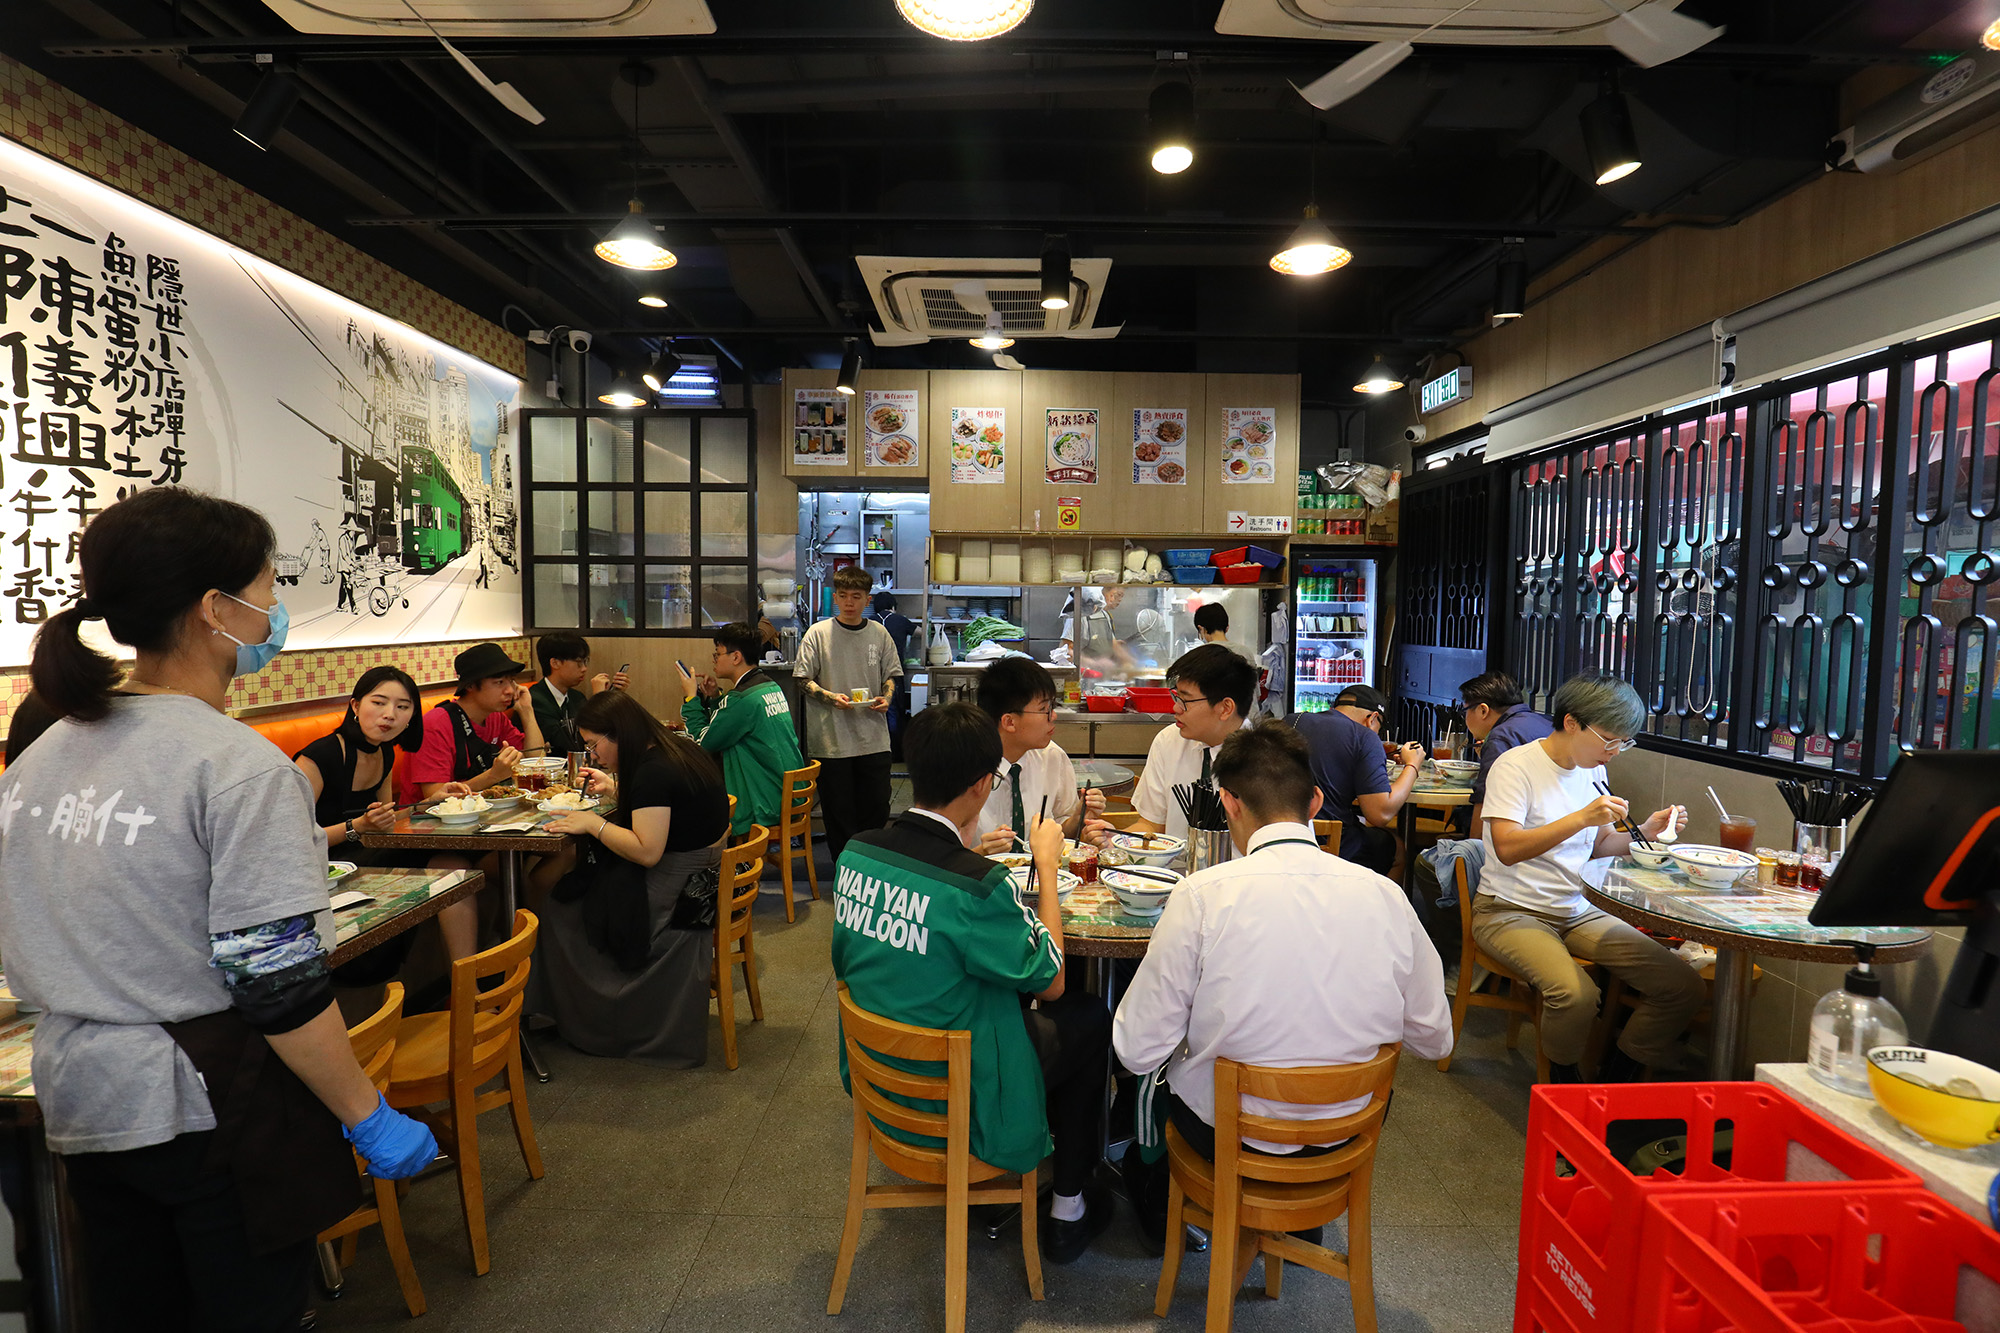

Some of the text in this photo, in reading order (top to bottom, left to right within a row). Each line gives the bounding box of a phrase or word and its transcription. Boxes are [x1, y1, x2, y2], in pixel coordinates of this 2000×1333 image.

[1423, 371, 1457, 411] EXIT 出口
[1249, 517, 1274, 526] 洗手間
[837, 864, 931, 925] WAH YAN
[1545, 1250, 1596, 1320] TO REUSE
[1549, 1241, 1593, 1300] RETURN
